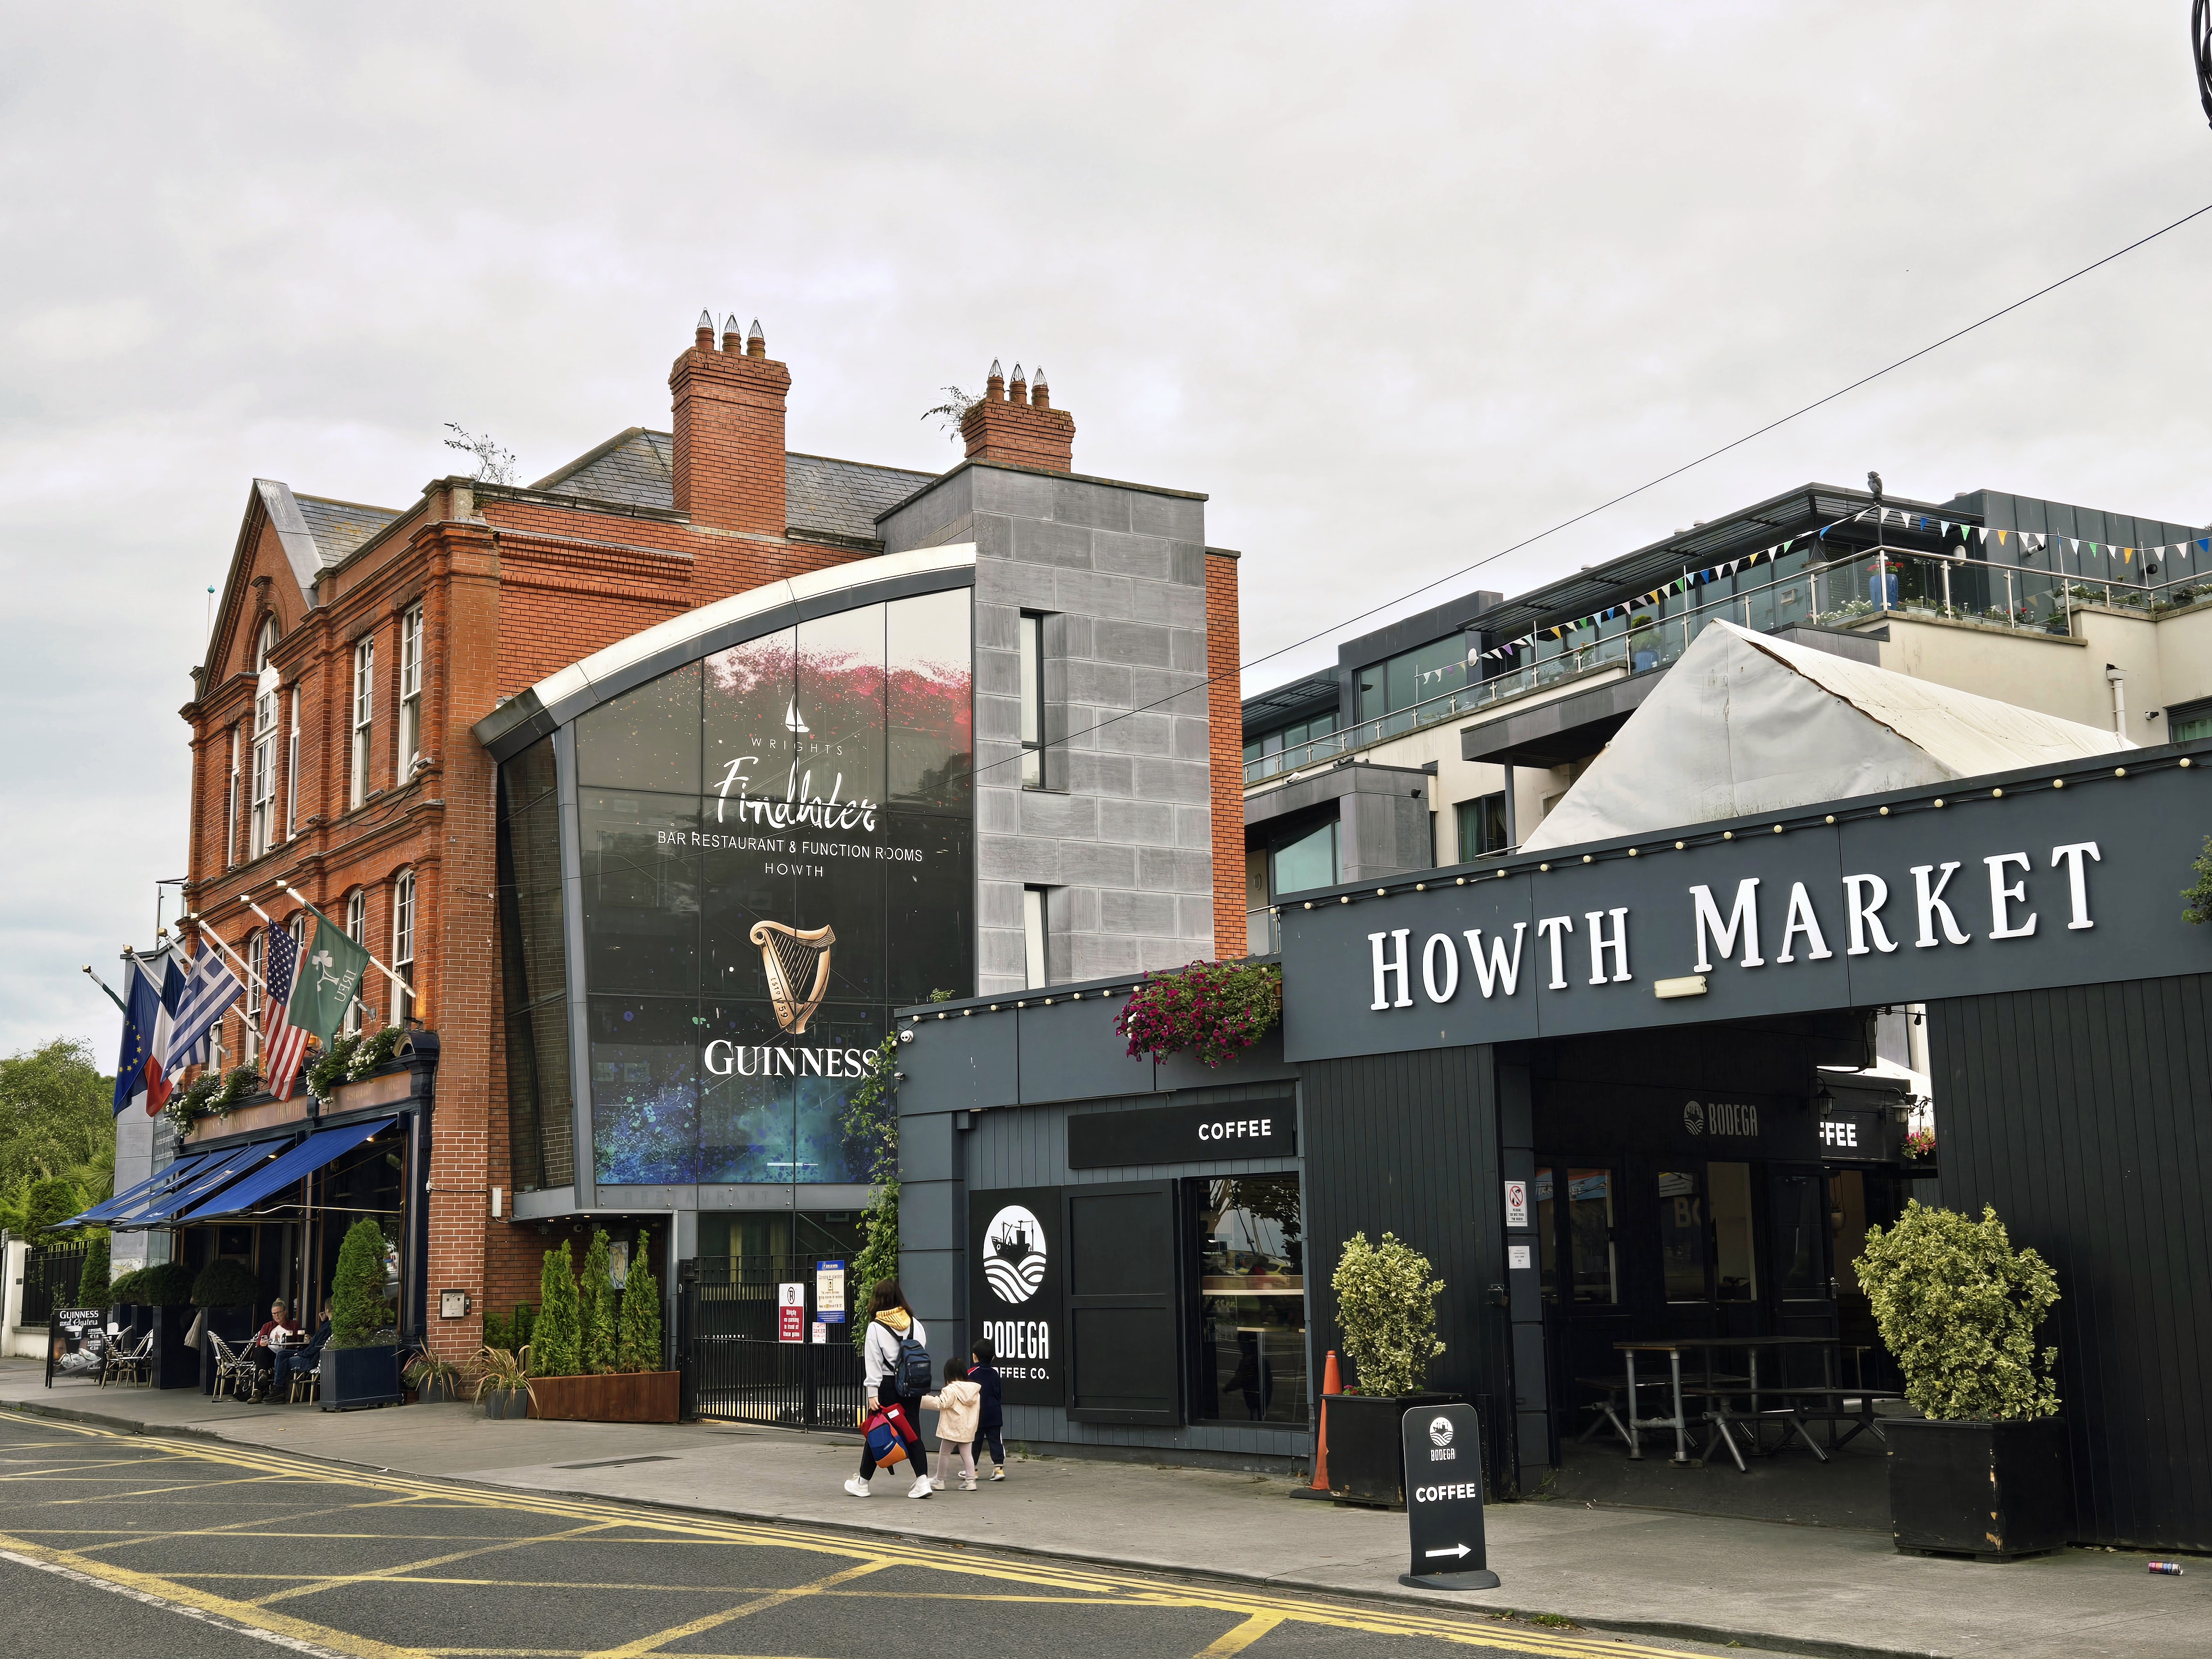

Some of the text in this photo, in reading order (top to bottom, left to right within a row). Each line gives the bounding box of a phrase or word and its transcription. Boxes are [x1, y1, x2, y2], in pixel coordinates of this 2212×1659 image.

[750, 737, 843, 755] WRIGHTS
[713, 755, 878, 832] Findlater
[658, 831, 923, 862] BAR RESTAURANT & FUNCTION ROOMS
[764, 862, 824, 878] HOWTH
[1368, 841, 2102, 1011] HOWTH MARKET
[703, 1039, 879, 1078] GUINNESS
[1198, 1119, 1271, 1141] COFFEE
[1708, 1103, 1758, 1136] BODEGA
[59, 1310, 99, 1319] GUINNESS
[991, 1366, 1050, 1380] FFEE CO.
[1430, 1448, 1455, 1462] BODEGA
[1415, 1483, 1476, 1503] COFFEE
